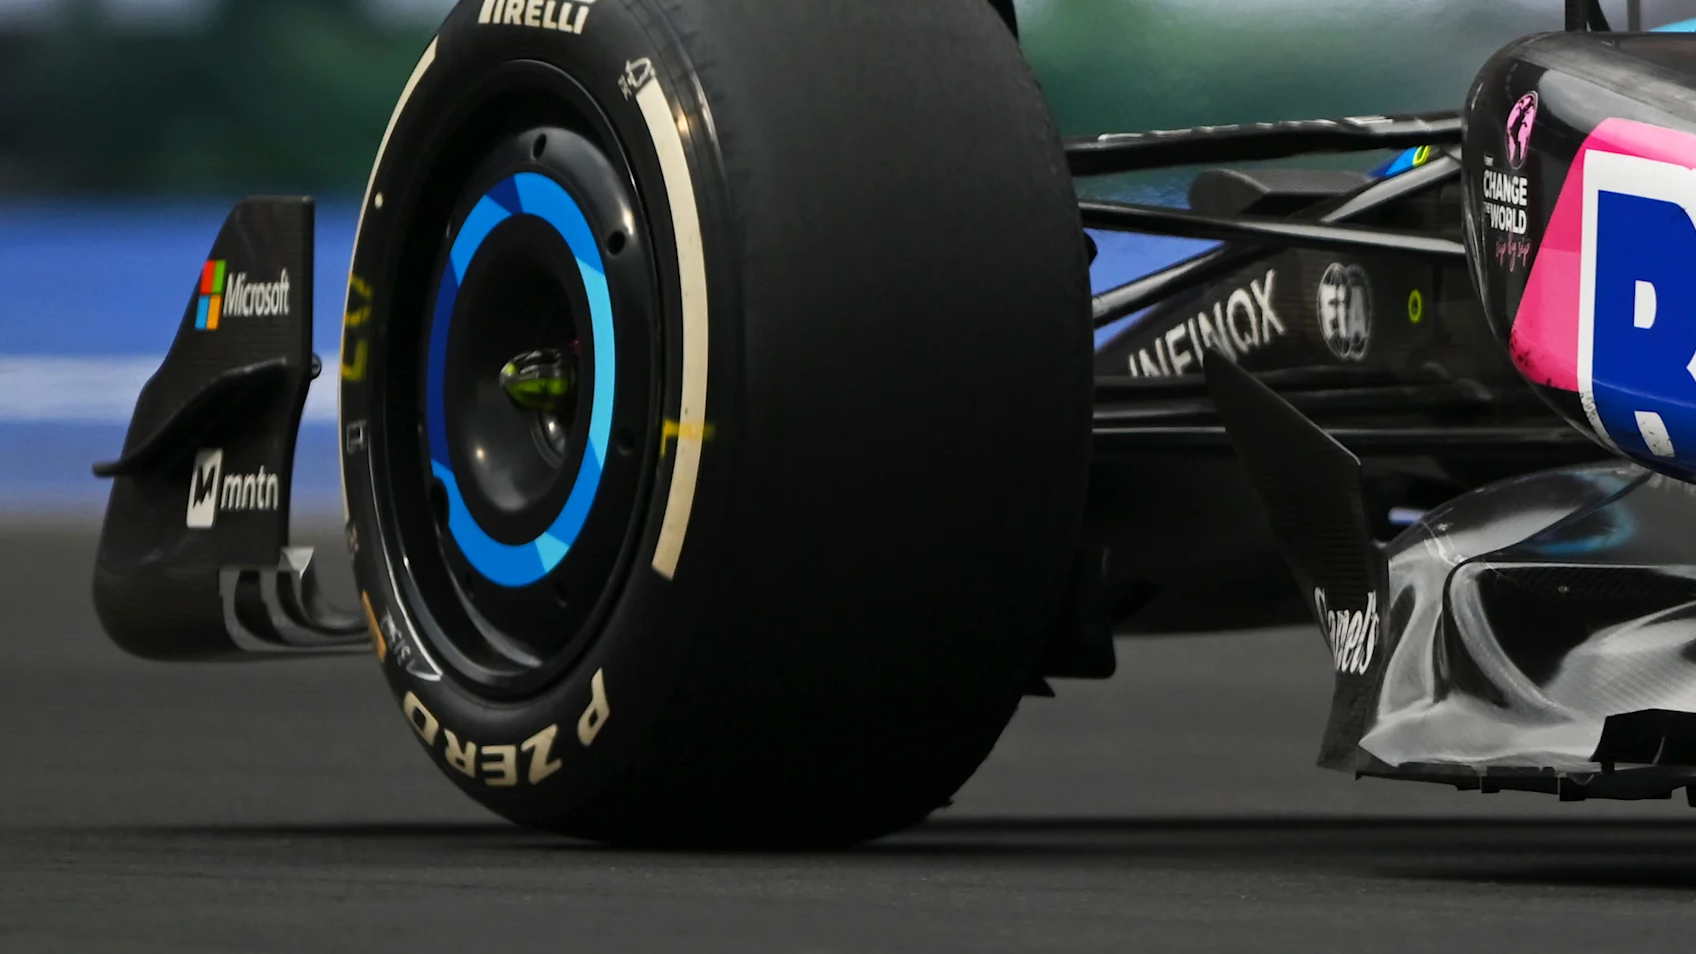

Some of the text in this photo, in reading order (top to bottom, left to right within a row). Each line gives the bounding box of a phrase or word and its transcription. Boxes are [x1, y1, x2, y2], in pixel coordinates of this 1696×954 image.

[1483, 169, 1528, 207] CHANGE
[1490, 206, 1527, 235] WORLD
[223, 268, 290, 318] Microsoft
[220, 464, 279, 511] mntn
